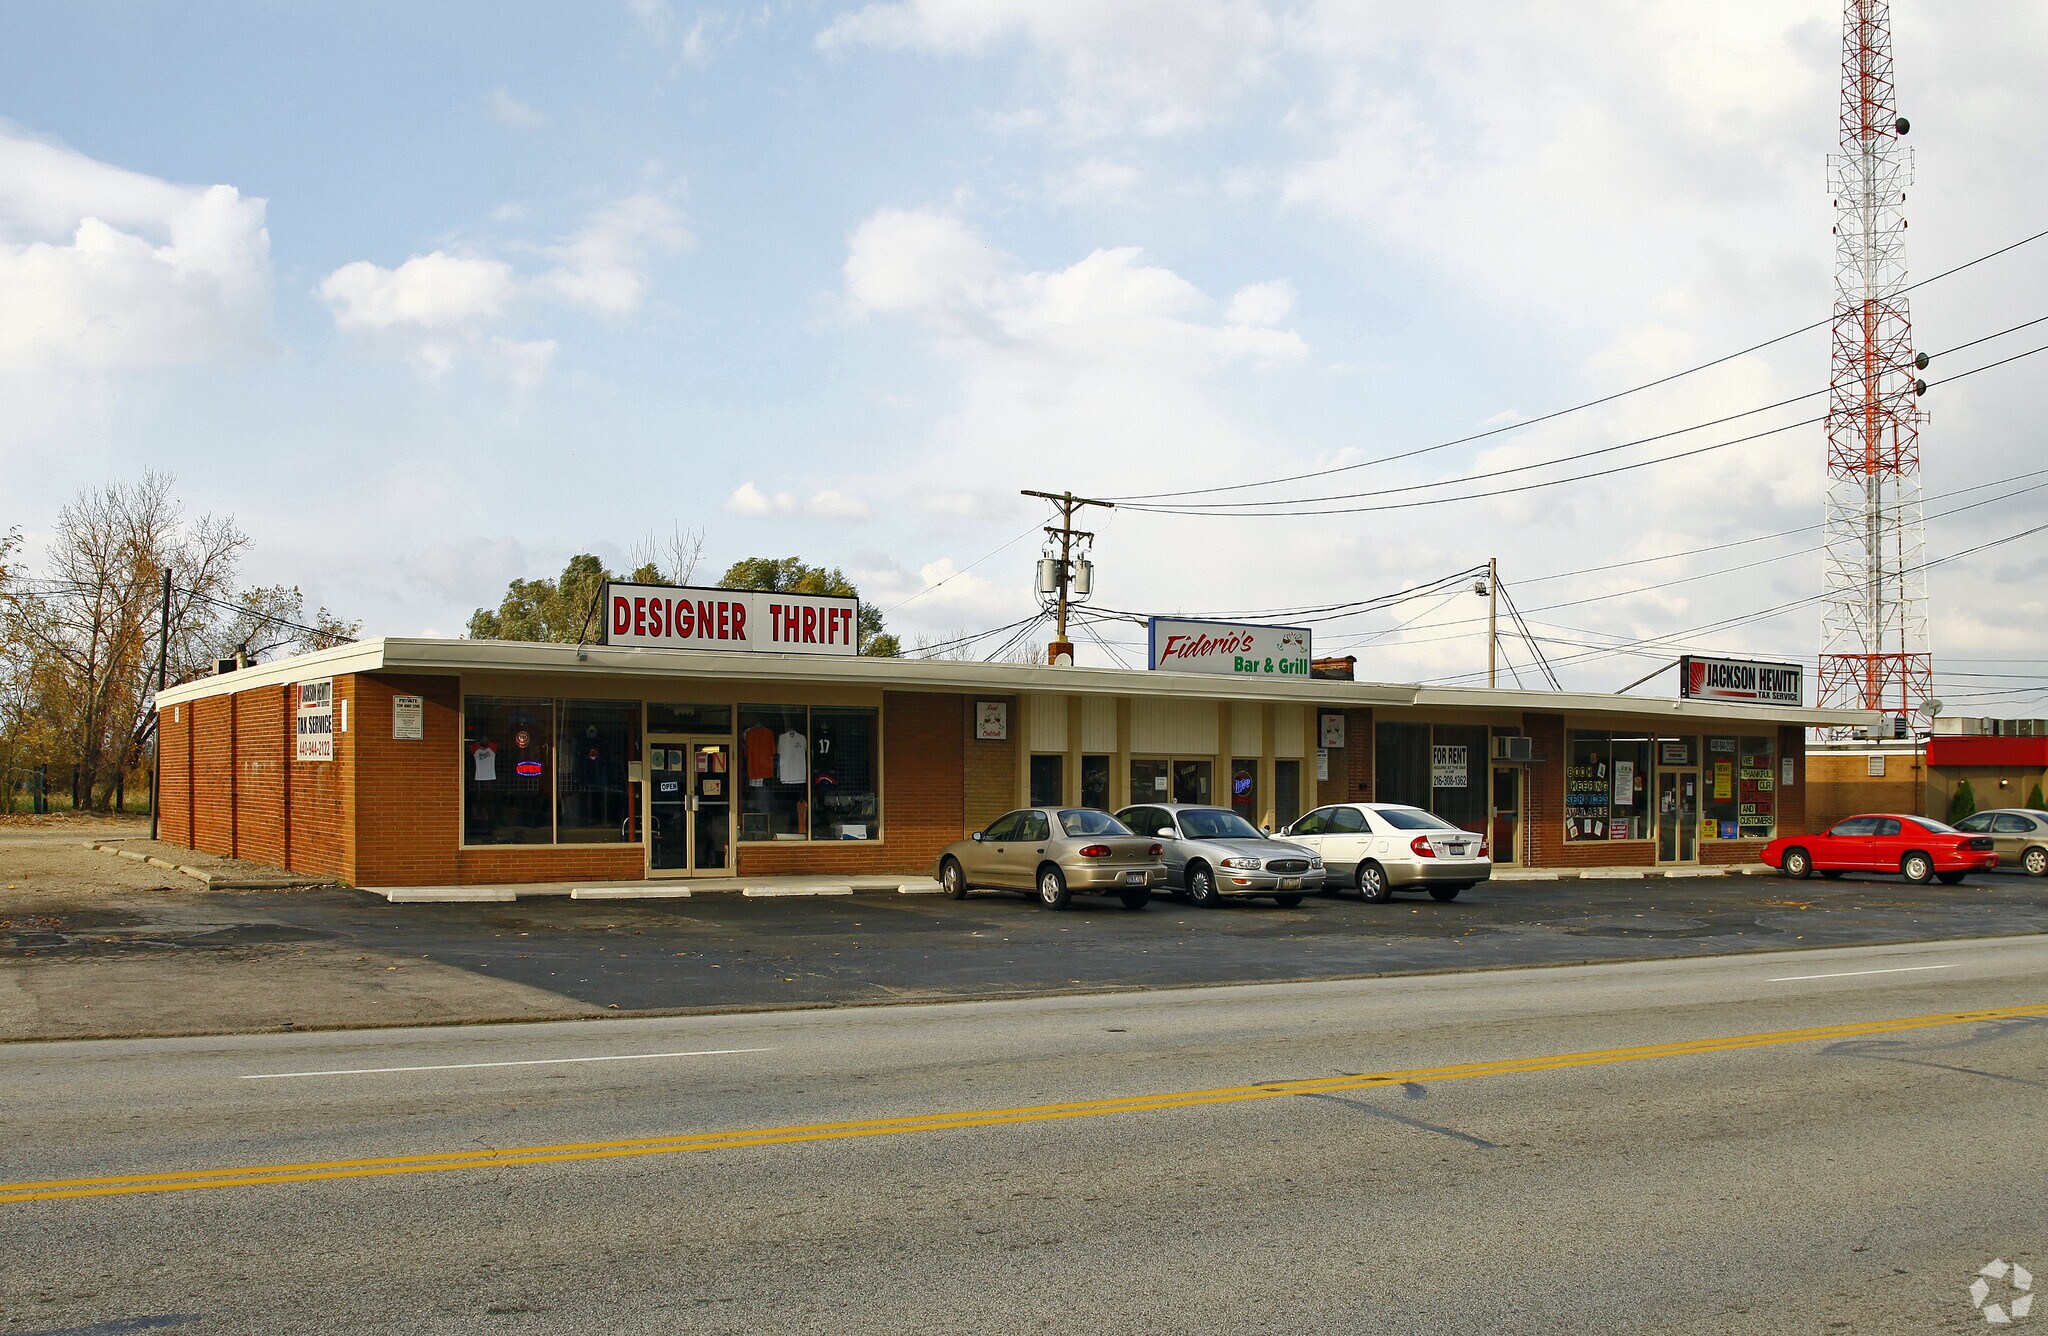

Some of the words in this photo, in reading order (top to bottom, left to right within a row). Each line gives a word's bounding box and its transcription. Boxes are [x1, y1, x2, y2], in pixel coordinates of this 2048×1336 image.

[613, 597, 747, 640] DESIGNER
[769, 604, 853, 645] THRIFT
[1159, 630, 1255, 666] Fiderio's
[1234, 656, 1260, 672] Bar
[1264, 658, 1275, 673] &
[1279, 659, 1308, 675] Grill
[1706, 664, 1756, 690] JACKSON
[1759, 668, 1800, 693] HEWITT
[302, 684, 316, 702] JACKSON
[317, 682, 331, 700] HEWITT
[1758, 691, 1771, 699] TAX
[1772, 692, 1798, 701] SERVICE
[297, 716, 308, 734] TAX
[308, 714, 332, 734] SERVICE
[299, 740, 331, 756] 440-944-2122
[819, 739, 830, 754] 17
[1433, 747, 1446, 764] FOR
[1449, 747, 1466, 764] RENT
[1742, 756, 1753, 765] WE
[1567, 767, 1593, 778] BOOK
[1742, 769, 1772, 778] THANKFUL
[1433, 775, 1467, 786] 216-308-1362
[1571, 780, 1609, 792] KEEPING
[1759, 781, 1772, 789] OUR
[1566, 794, 1609, 805] SERVICES
[1565, 807, 1608, 817] AVAILABLE
[1742, 804, 1754, 812] AND
[1740, 816, 1774, 825] CUSTOMERS
